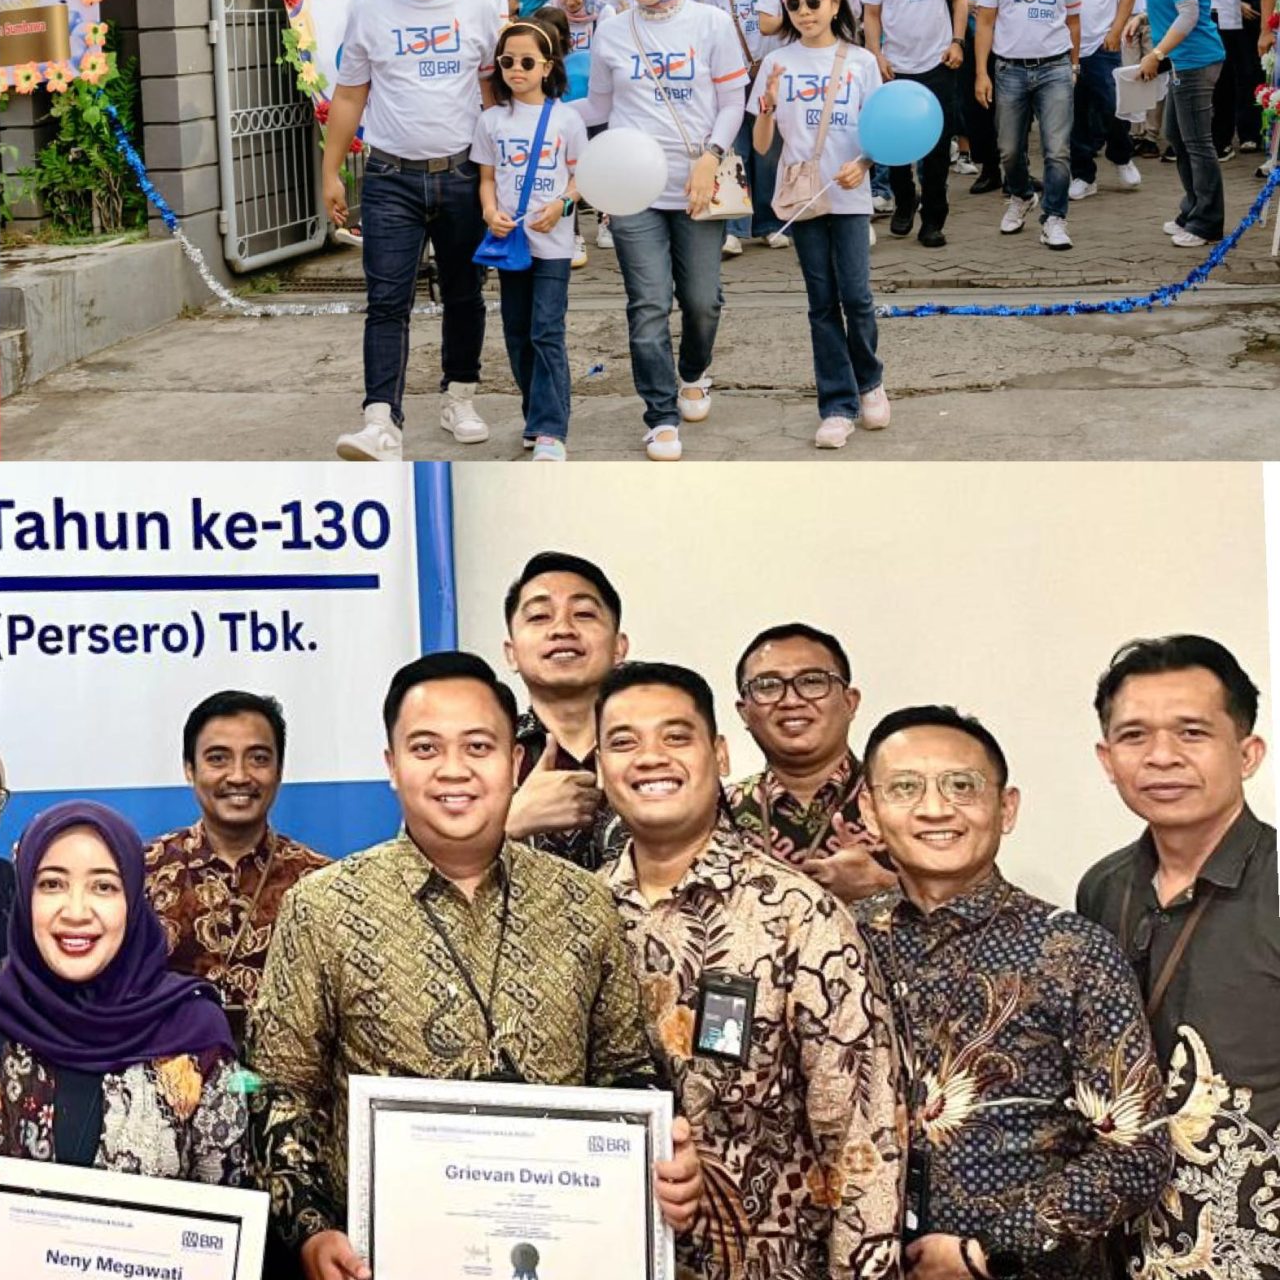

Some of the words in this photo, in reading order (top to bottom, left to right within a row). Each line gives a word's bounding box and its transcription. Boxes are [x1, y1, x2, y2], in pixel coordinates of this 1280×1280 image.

[391, 22, 461, 56] 130
[436, 60, 461, 74] BRI
[629, 48, 696, 81] 130
[783, 72, 852, 105] 130
[497, 136, 561, 170] 130
[192, 497, 392, 552] ke-130
[219, 610, 318, 655] Tbk.
[606, 1138, 631, 1153] BRI
[445, 1163, 516, 1184] Grievan
[519, 1166, 554, 1185] Dwi
[558, 1168, 601, 1188] Okta
[199, 1233, 224, 1250] BRI
[45, 1247, 92, 1272] Neny
[96, 1257, 183, 1280] Megawati
